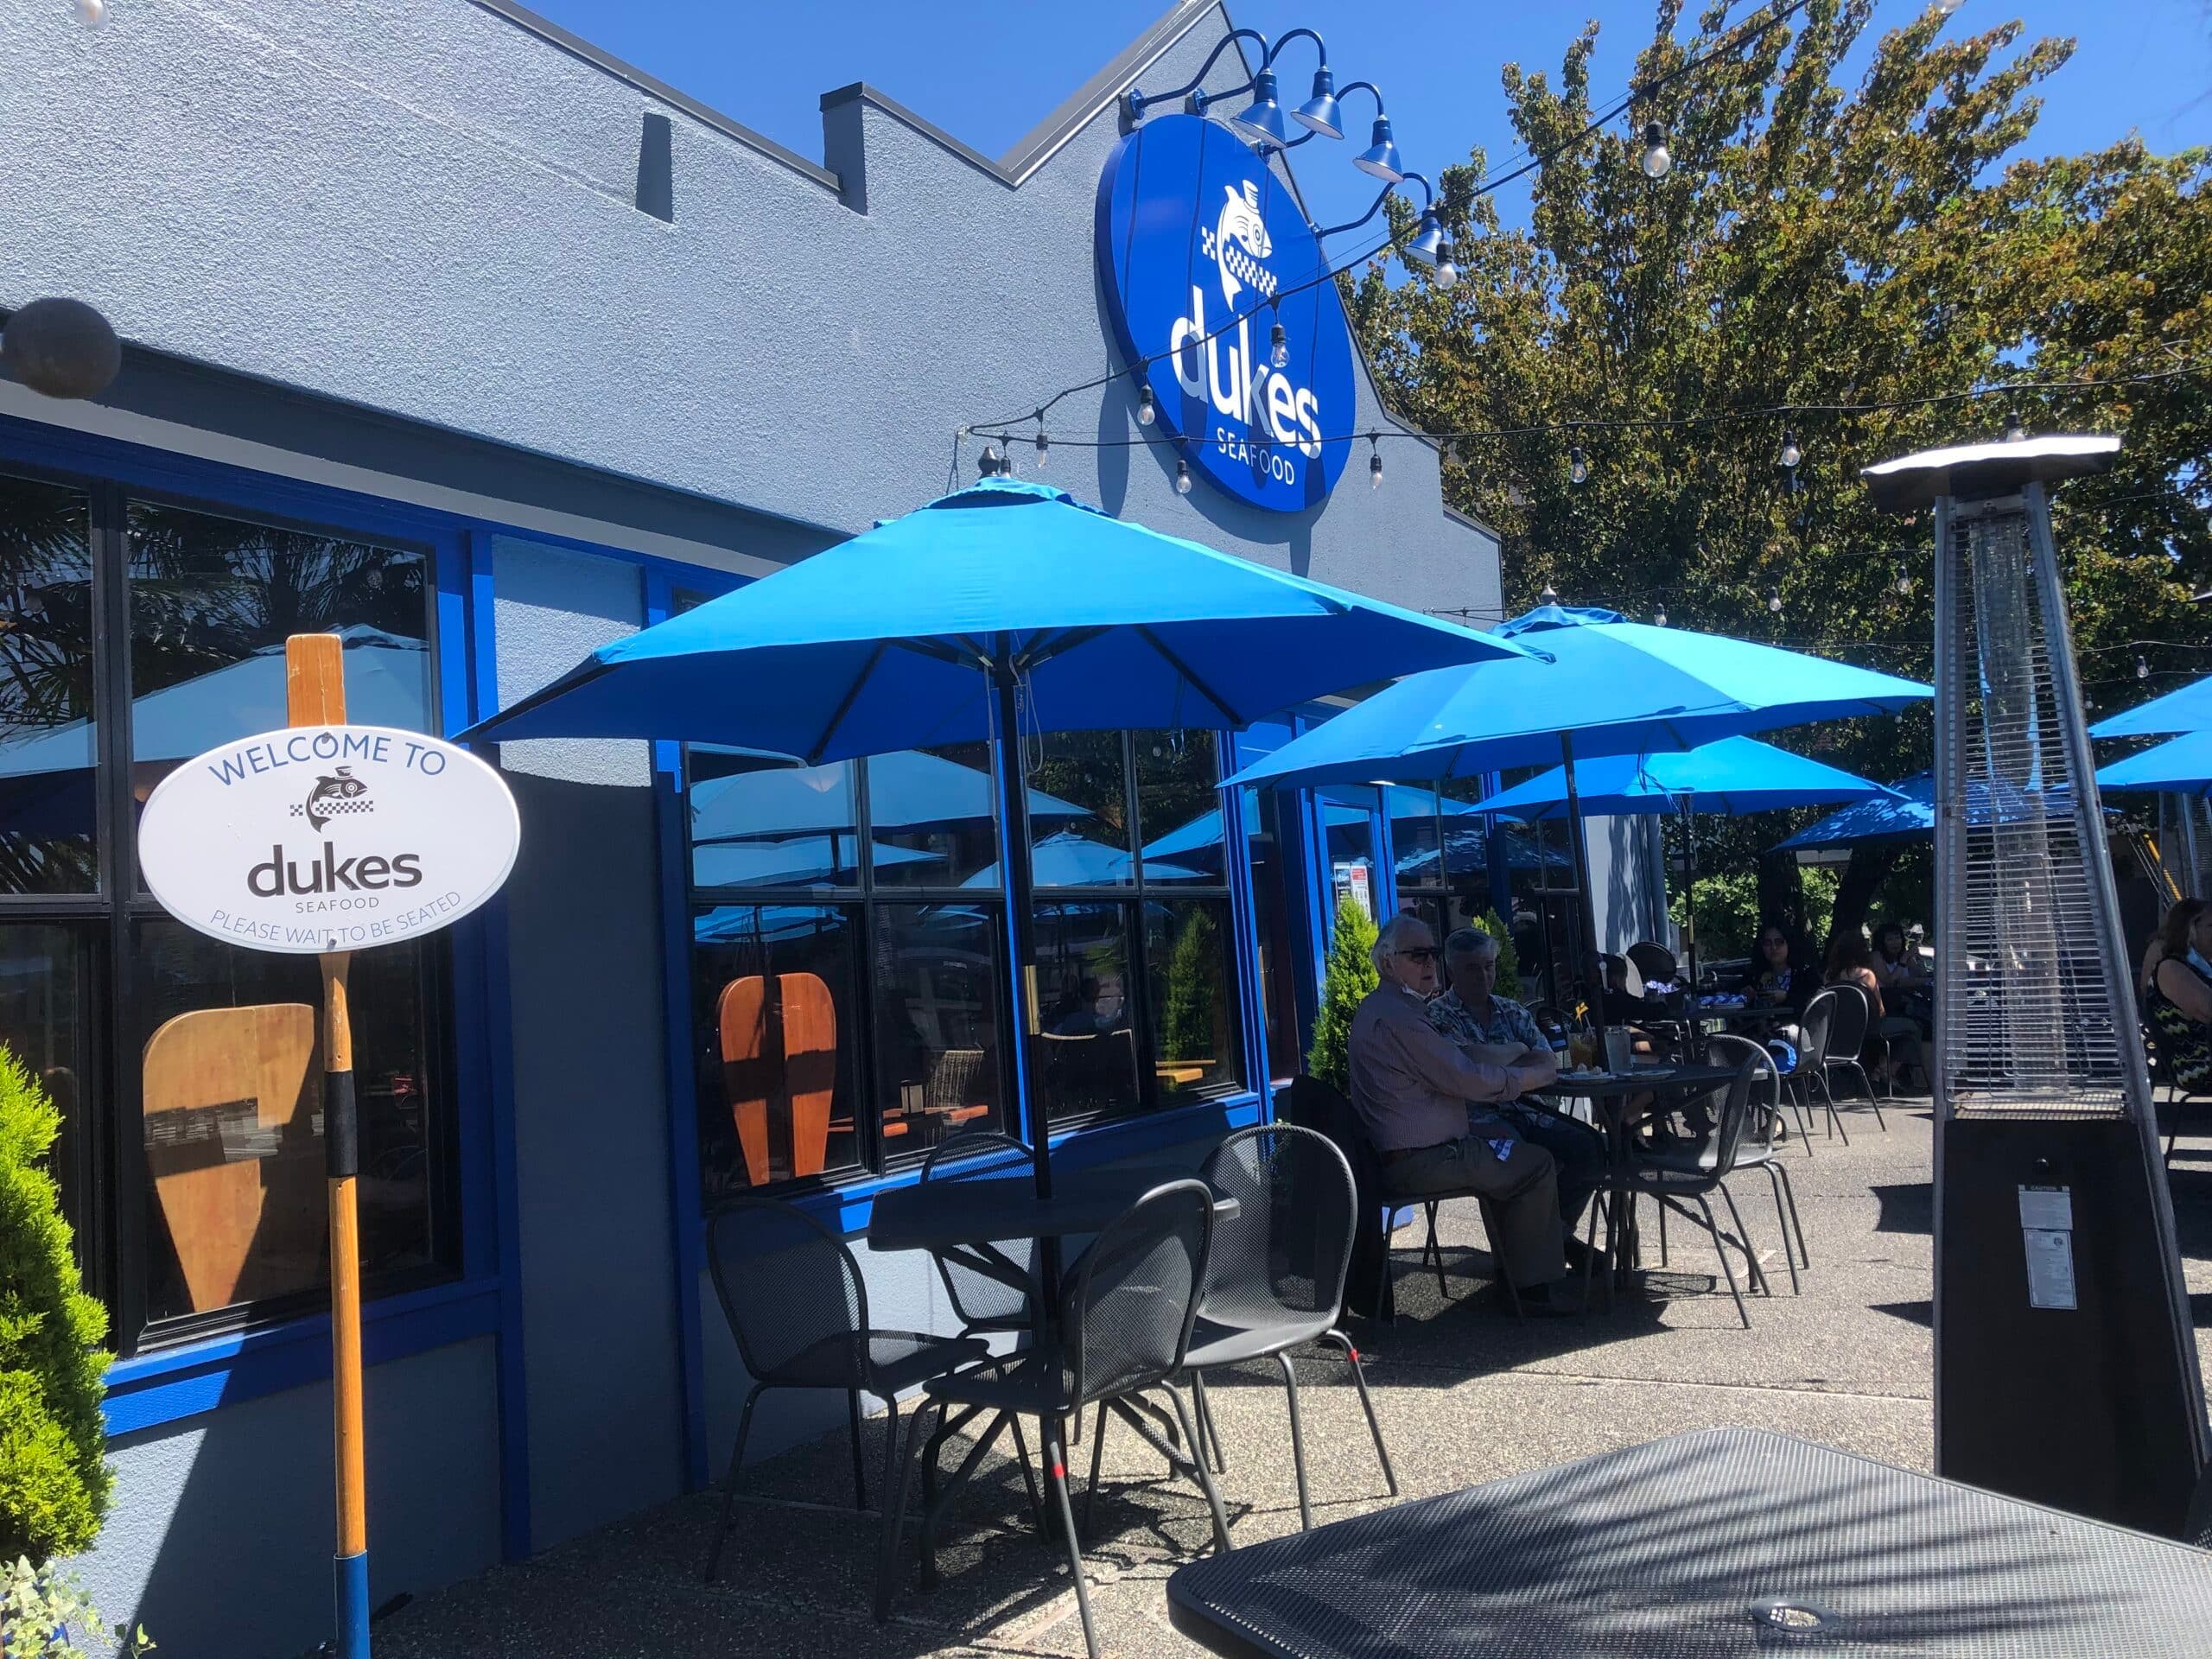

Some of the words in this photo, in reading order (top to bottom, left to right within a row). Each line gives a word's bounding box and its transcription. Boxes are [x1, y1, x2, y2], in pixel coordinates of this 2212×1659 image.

[1170, 285, 1322, 459] dukes
[1217, 427, 1295, 486] SEAFOOD
[207, 733, 392, 785] WELCOME
[404, 741, 446, 776] TO
[247, 841, 423, 898] dukes
[210, 909, 282, 941] PLEASE
[285, 927, 334, 944] WAIT
[338, 925, 365, 943] TO
[370, 918, 395, 938] BE
[397, 891, 461, 931] SEATED
[295, 897, 379, 914] SEAFOOD
